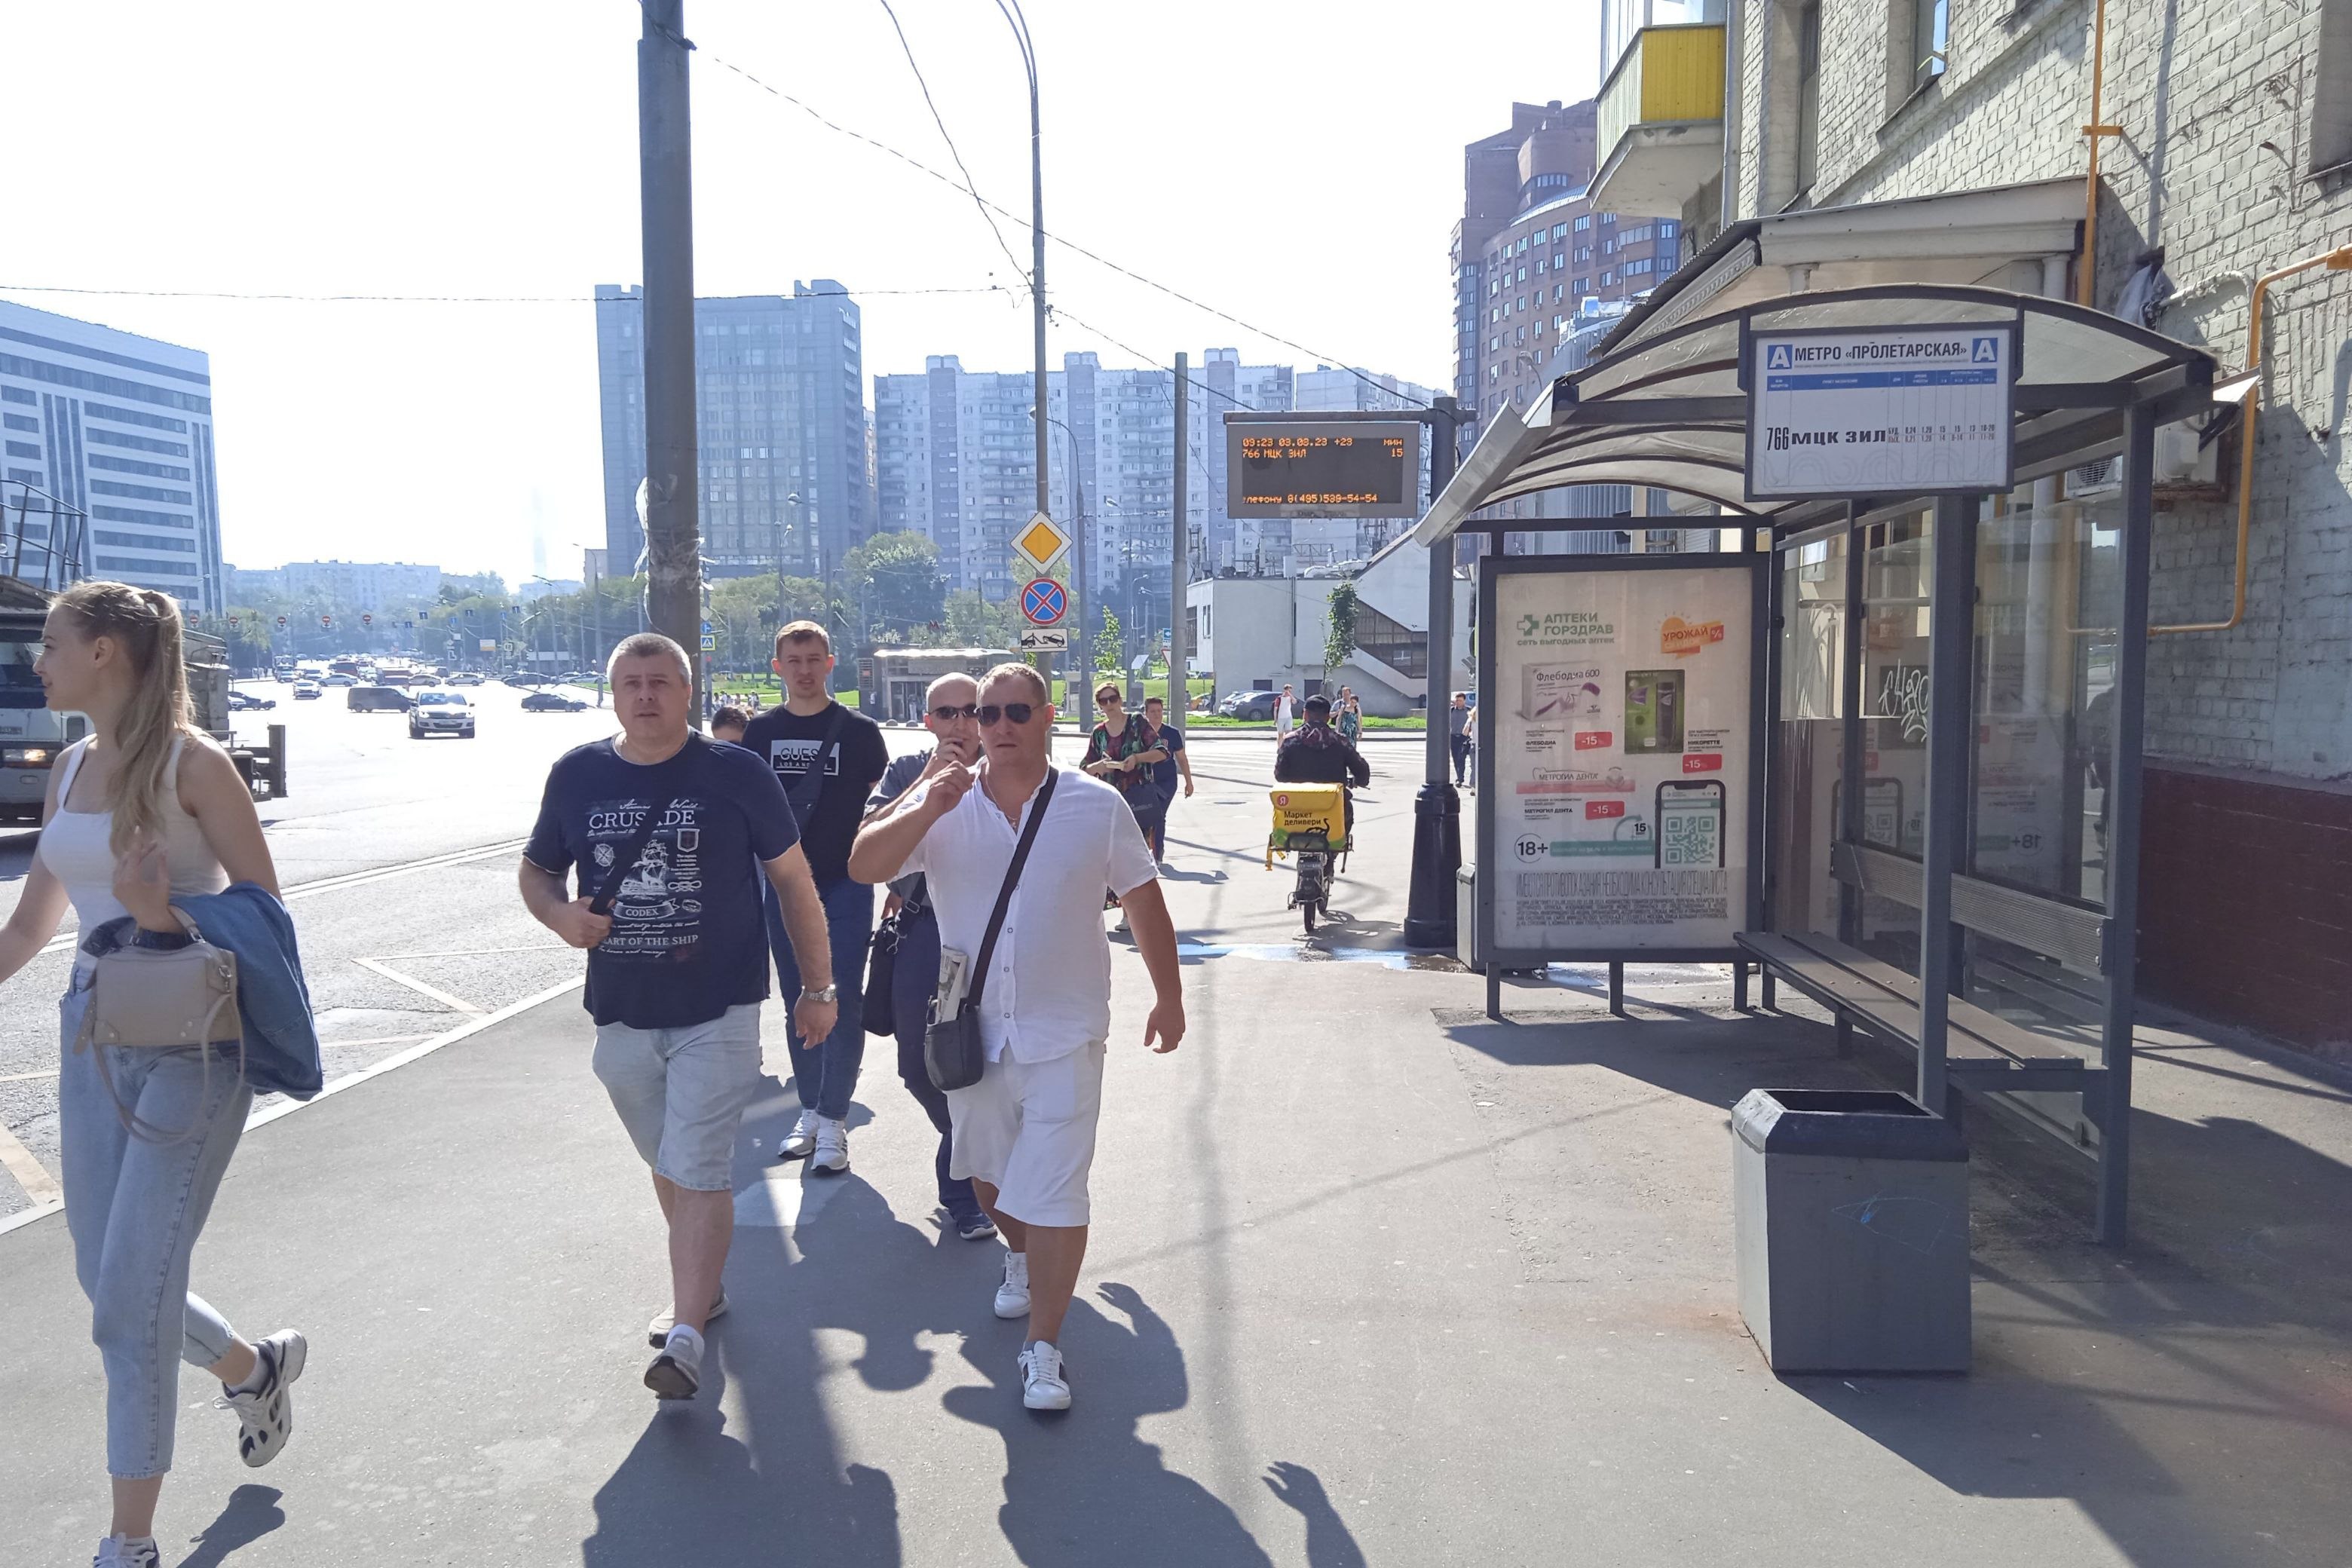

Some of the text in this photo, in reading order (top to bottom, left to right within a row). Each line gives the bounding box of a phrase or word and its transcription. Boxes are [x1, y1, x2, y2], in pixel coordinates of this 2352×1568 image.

[1794, 342, 1967, 361] МЕТРО «ПРОЛЕТАРСКАЯ»
[1242, 437, 1274, 447] 09:23
[1334, 437, 1353, 446] +23
[1766, 427, 1886, 451] 766 МЦК ЗИЛ
[1242, 449, 1306, 459] 766 МЦК ЗИЛ
[1391, 448, 1403, 458] 15
[1543, 612, 1598, 623] АПТЕКИ
[1544, 624, 1614, 636] ГОРЗДРАВ
[1663, 626, 1708, 642] УРОЖАЙ
[1536, 669, 1600, 681] Флебодиа 600
[780, 748, 819, 761] GUES
[589, 809, 696, 830] CRUSDE
[1634, 822, 1647, 832] 15
[1517, 841, 1549, 856] 18+
[625, 908, 660, 917] CODEX
[628, 937, 643, 946] OF
[645, 937, 670, 946] THE
[671, 934, 699, 946] SHIP
